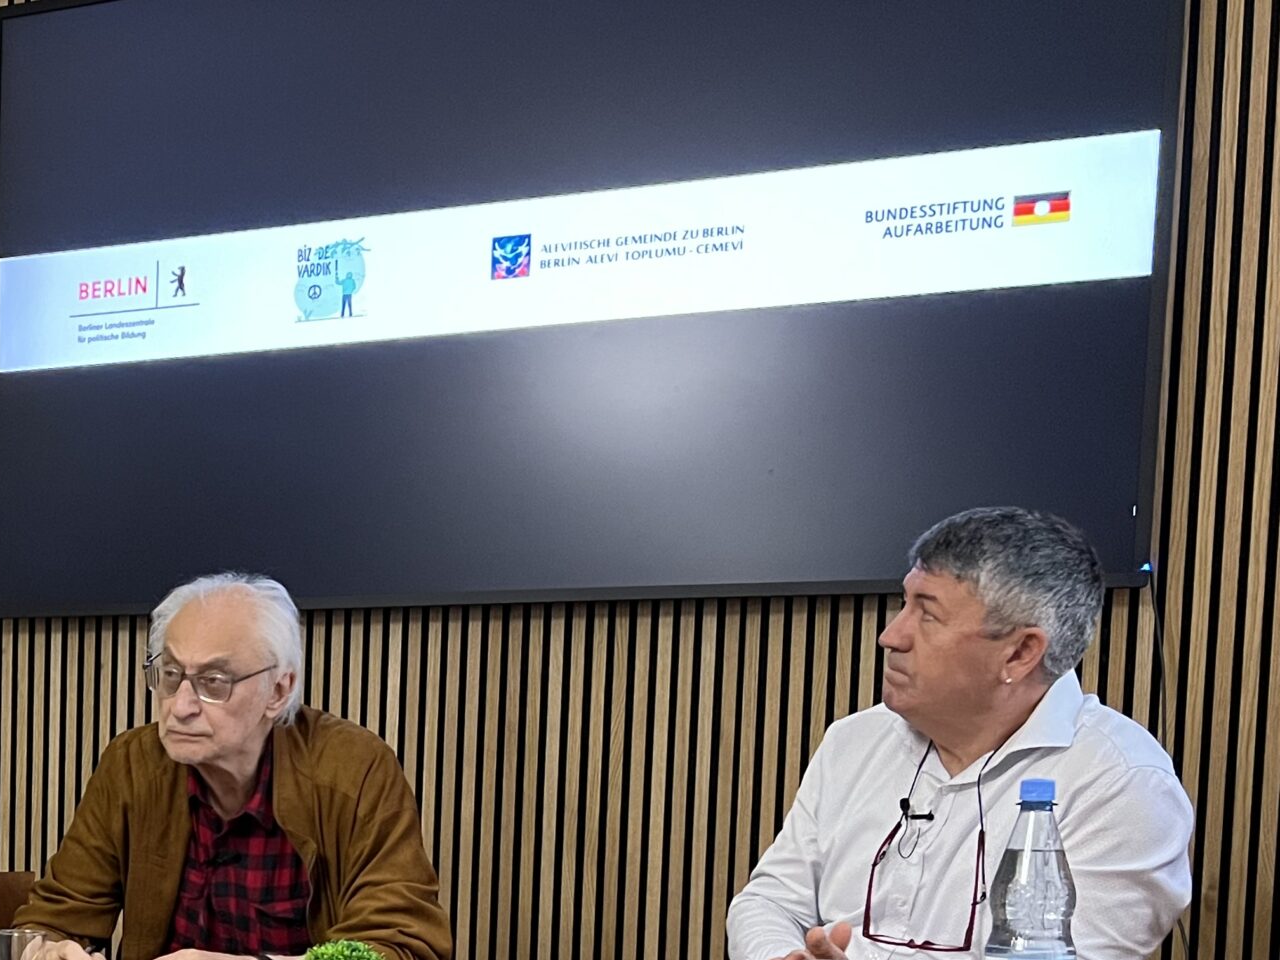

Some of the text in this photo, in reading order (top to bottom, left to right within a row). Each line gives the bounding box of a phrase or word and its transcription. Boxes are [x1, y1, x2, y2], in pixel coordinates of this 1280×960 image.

[864, 197, 1006, 224] BUNDESSTIFTUNG
[615, 231, 678, 248] GEMEINDE
[682, 228, 699, 241] ZU
[702, 224, 745, 239] BERLIN
[882, 215, 1005, 239] AUFARBEITUNG
[625, 245, 686, 261] TOPLUMU
[79, 275, 148, 301] BERLIN
